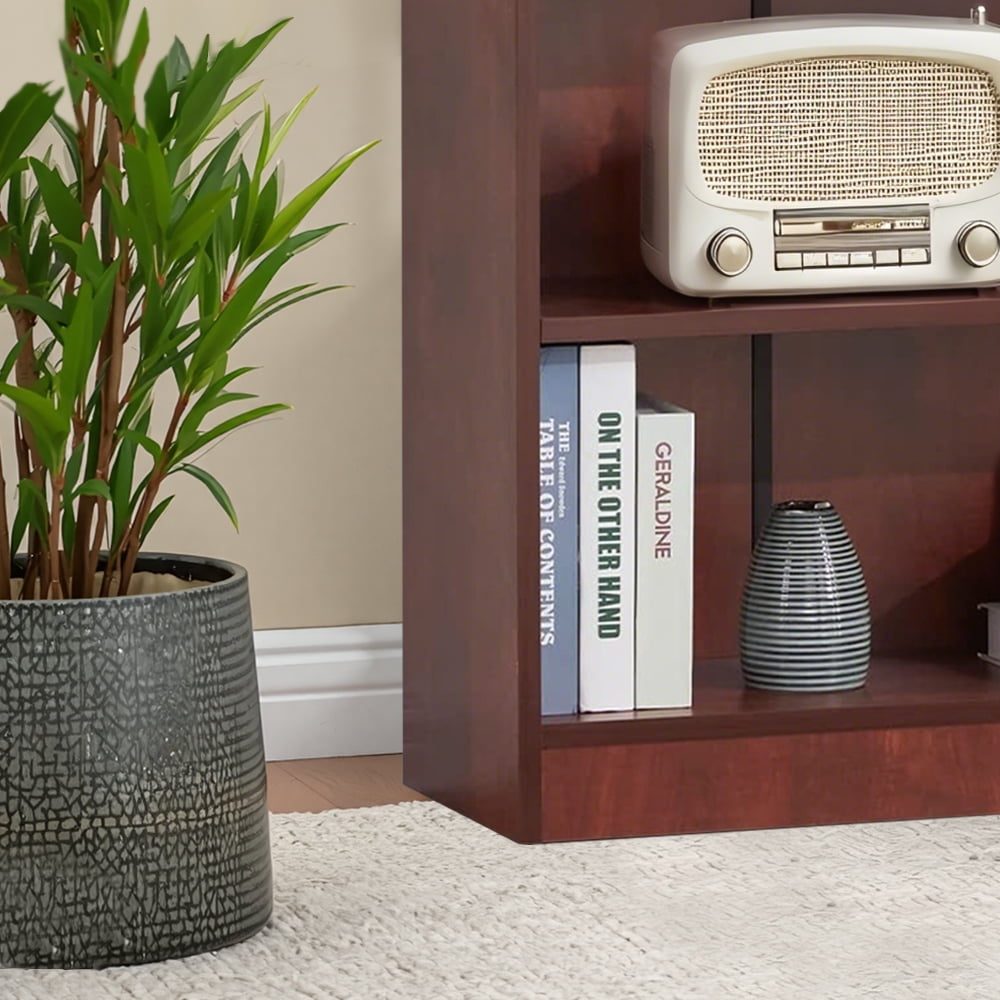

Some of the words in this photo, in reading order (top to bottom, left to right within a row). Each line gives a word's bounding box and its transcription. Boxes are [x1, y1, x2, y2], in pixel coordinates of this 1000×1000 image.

[540, 418, 555, 487] TABLE
[558, 421, 570, 453] THE
[597, 411, 622, 444] ON
[597, 447, 622, 492] THE
[654, 441, 673, 560] GERALDINE
[540, 492, 555, 523] OF
[597, 496, 622, 571] OTHER
[540, 528, 555, 646] CONTENTS
[597, 575, 621, 640] HAND
